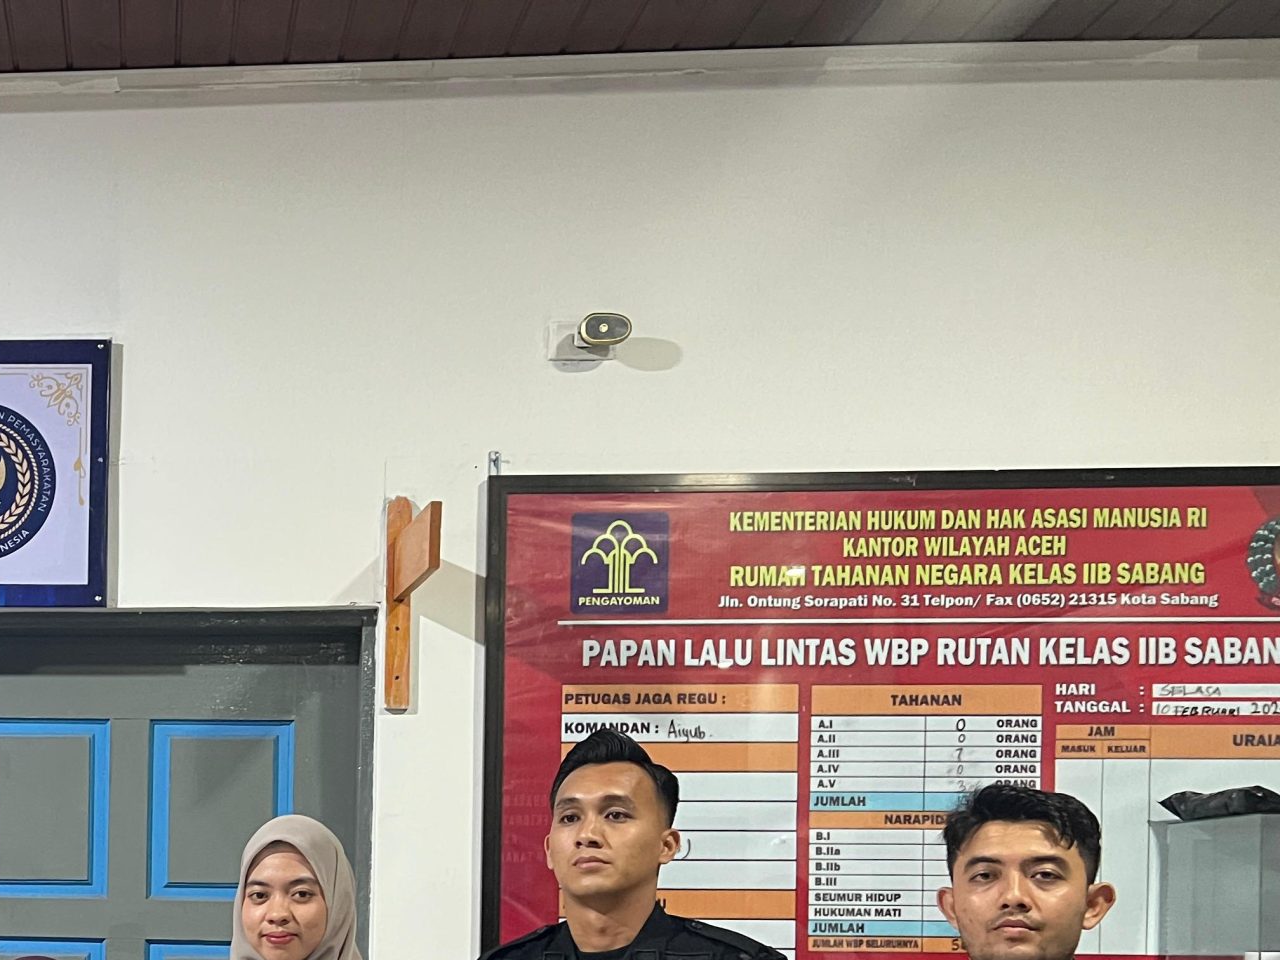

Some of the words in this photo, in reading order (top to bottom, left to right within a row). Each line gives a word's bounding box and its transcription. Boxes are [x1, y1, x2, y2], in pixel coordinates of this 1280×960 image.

[6, 414, 52, 512] PEMASYARAKATAN
[729, 511, 862, 532] KEMENTERIAN
[867, 511, 936, 531] HUKUM
[941, 510, 981, 530] DAN
[986, 509, 1026, 529] HAK
[1031, 508, 1088, 529] ASASI
[1093, 508, 1182, 528] MANUSIA
[1187, 508, 1208, 528] RI
[843, 537, 919, 558] KANTOR
[924, 536, 1010, 556] WILAYAH
[1014, 535, 1066, 556] ACEH
[730, 565, 806, 587] RUMAH
[811, 564, 910, 587] TAHANAN
[915, 564, 1003, 586] NEGARA
[1009, 563, 1077, 585] KELAS
[1082, 562, 1112, 585] IIB
[1116, 562, 1205, 585] SABANG
[578, 596, 660, 606] PENGAYOMAN
[718, 596, 744, 608] Jln.
[746, 595, 801, 610] Ontung
[804, 595, 868, 610] Sorapati
[872, 595, 897, 607] No.
[900, 595, 920, 606] 31
[922, 594, 982, 608] Telpon/
[986, 593, 1013, 606] Fax
[1016, 593, 1066, 608] (0652)
[1068, 593, 1117, 606] 21315
[1121, 593, 1157, 605] Kota
[1160, 592, 1219, 608] Sabang
[582, 639, 676, 667] PAPAN
[684, 639, 753, 667] LALU
[760, 638, 857, 666] LINTAS
[863, 638, 929, 666] WBP
[937, 637, 1030, 666] RUTAN
[1039, 637, 1131, 665] KELAS
[1138, 637, 1177, 665] IIB
[1184, 636, 1280, 665] SABAN
[1055, 683, 1096, 696] HARI
[564, 692, 632, 705] PETUGAS
[634, 692, 673, 705] JAGA
[676, 692, 718, 705] REGU
[890, 694, 962, 707] TAHANAN
[1054, 700, 1131, 713] TANGGAL
[1249, 701, 1280, 715] 202
[564, 721, 651, 734] KOMANDAN
[996, 719, 1039, 729] ORANG
[1087, 726, 1116, 737] JAM
[995, 733, 1038, 744] ORANG
[1232, 733, 1280, 747] URAIA
[995, 748, 1038, 759] ORANG
[1060, 744, 1097, 754] MASUK
[1106, 744, 1147, 754] KELUAR
[816, 764, 840, 774] A.IV
[994, 764, 1037, 774] ORANG
[816, 779, 837, 789] A.V
[994, 779, 1037, 789] ORANG
[813, 795, 867, 807] JUMLAH
[883, 813, 946, 825] NARAPID
[813, 892, 863, 902] SEUMUR
[864, 893, 902, 902] HIDUP
[813, 907, 872, 918] HUKUMAN
[873, 908, 902, 918] MATI
[812, 923, 866, 935] JUMLAH
[811, 938, 844, 949] JUMLAH
